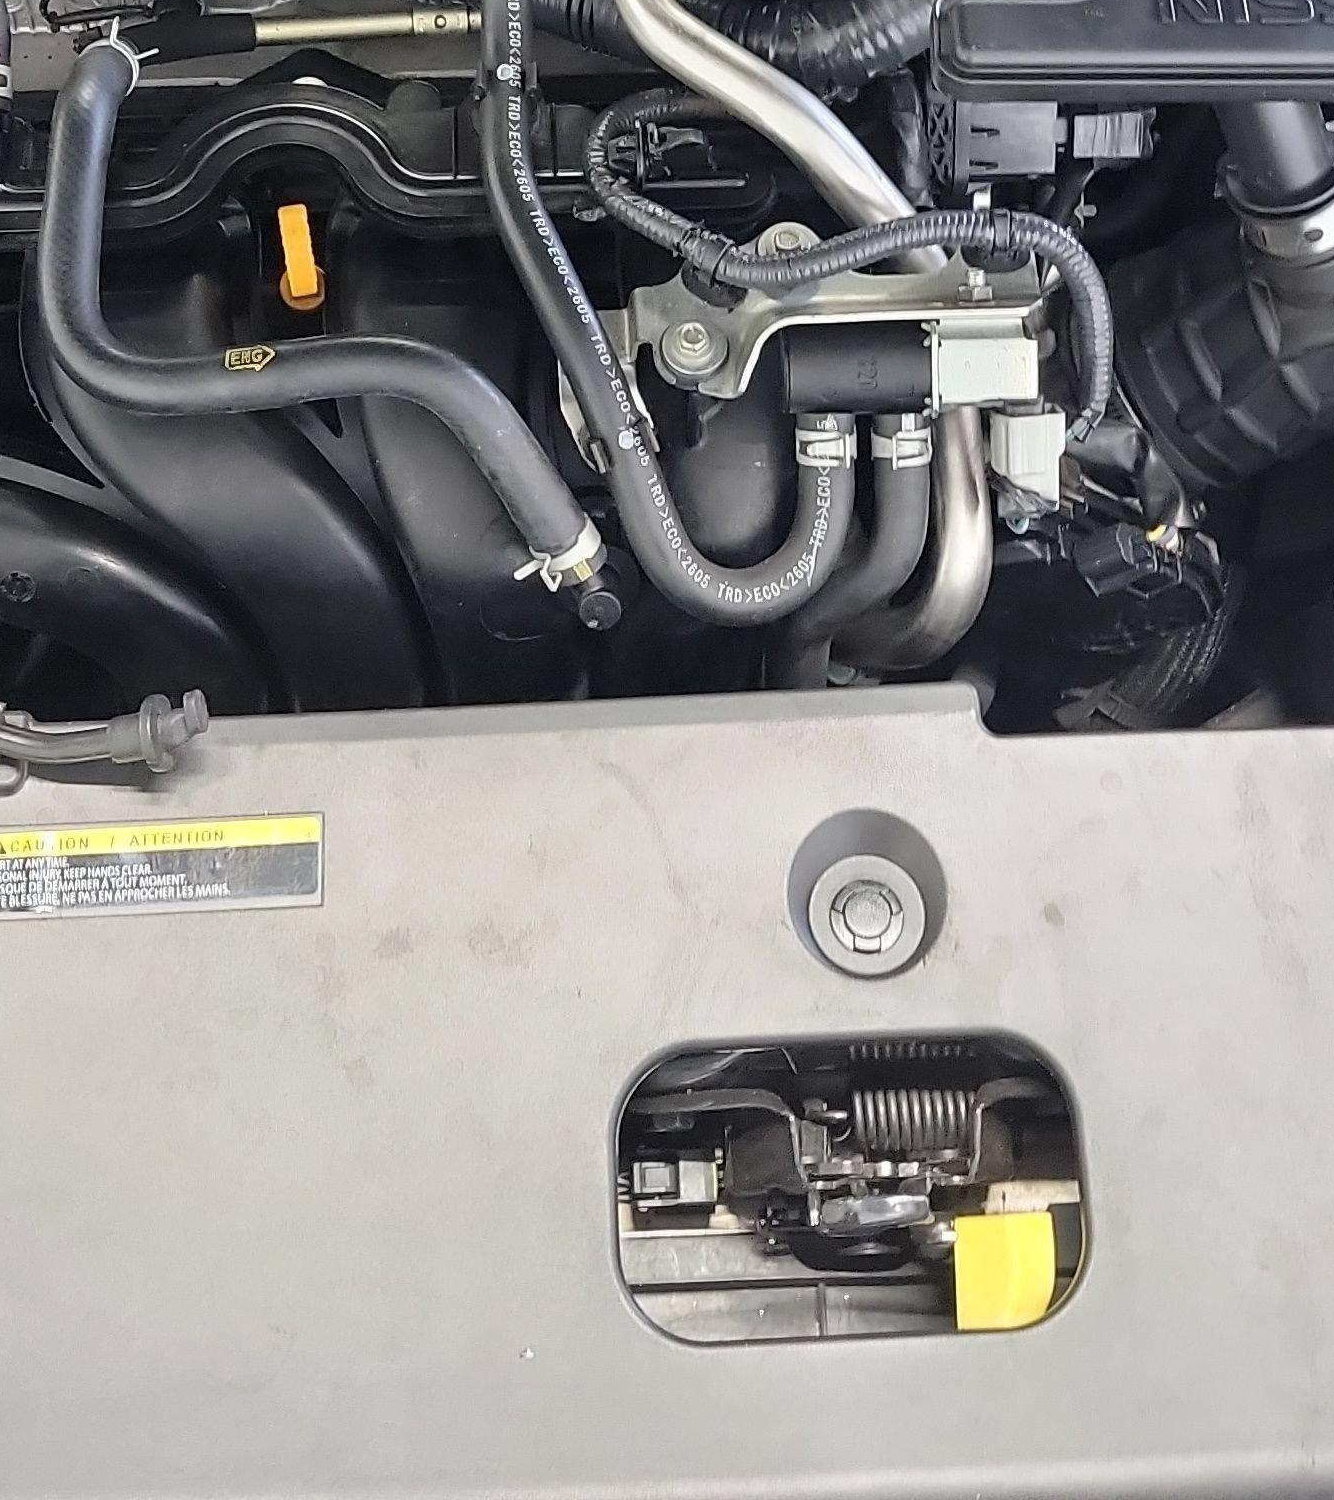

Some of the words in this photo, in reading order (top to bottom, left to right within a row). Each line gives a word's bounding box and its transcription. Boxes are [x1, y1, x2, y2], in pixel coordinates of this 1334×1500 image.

[230, 349, 263, 365] ENG
[10, 837, 90, 853] CAUION
[130, 829, 224, 847] ATTENTION
[12, 858, 23, 870] AT
[24, 856, 45, 869] ANY
[28, 881, 42, 893] DE
[110, 875, 138, 889] TOUT
[62, 892, 76, 905] NE
[78, 890, 97, 904] PAS
[98, 889, 113, 902] EN
[114, 886, 175, 902] APPROCHER
[176, 885, 193, 898] LES
